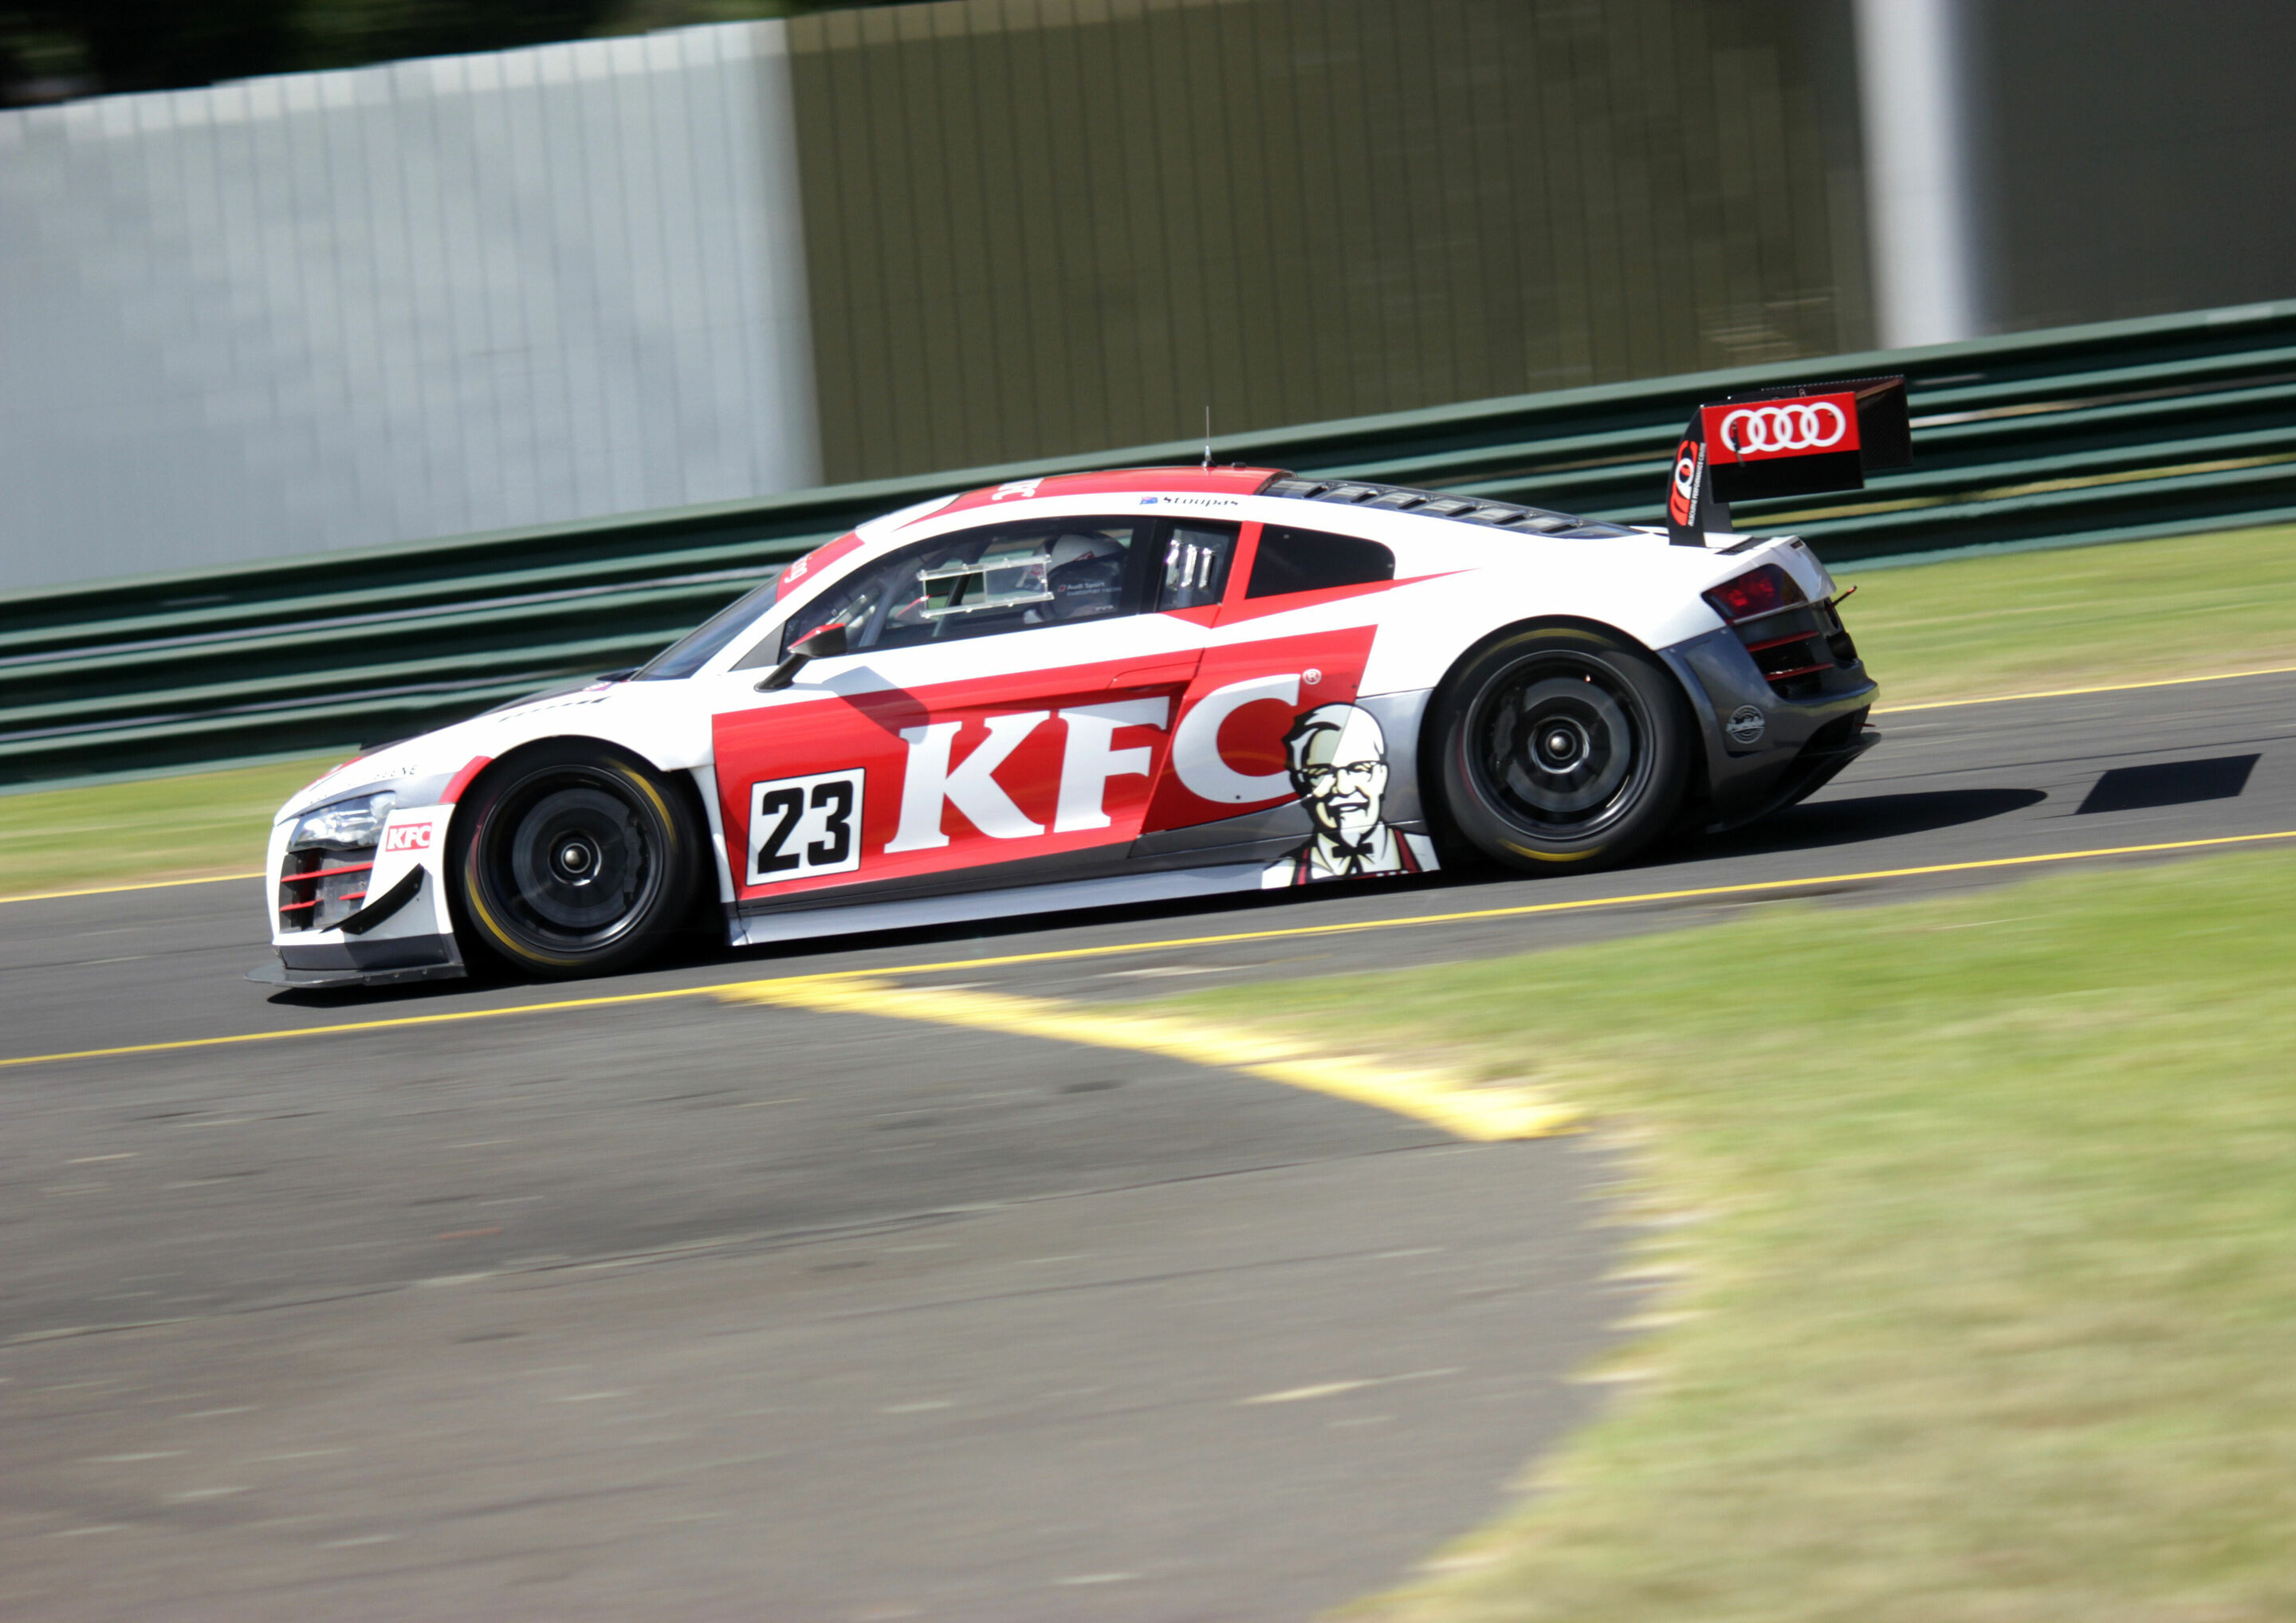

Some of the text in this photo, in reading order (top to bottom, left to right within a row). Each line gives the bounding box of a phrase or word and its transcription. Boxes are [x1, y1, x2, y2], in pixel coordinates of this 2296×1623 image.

[883, 673, 1311, 854] KFC
[388, 826, 431, 850] KFC
[757, 780, 853, 874] 23
